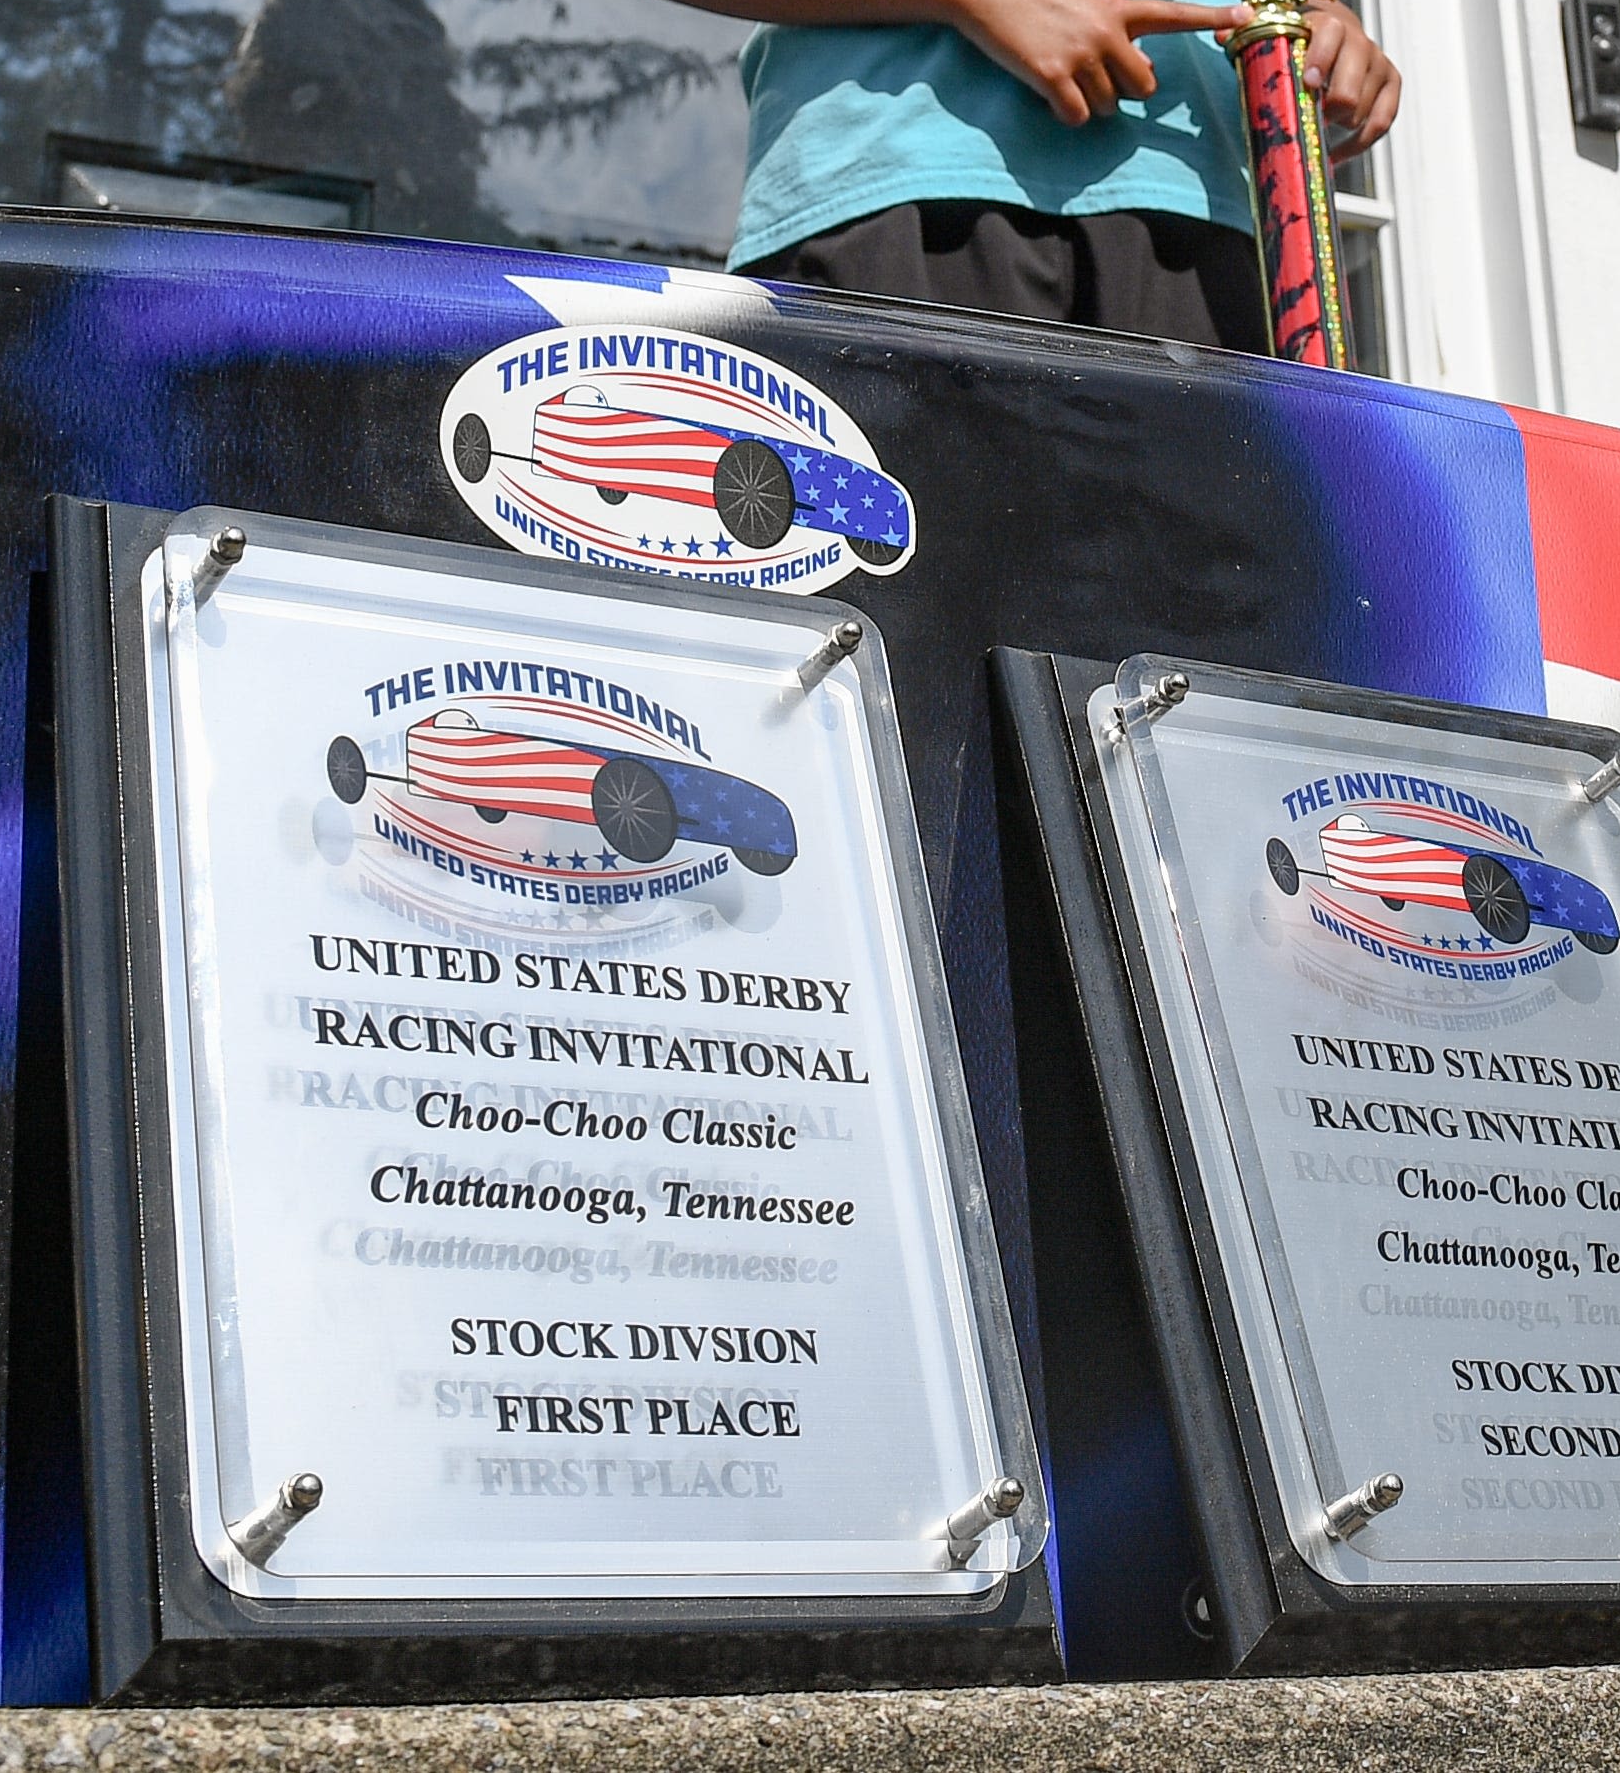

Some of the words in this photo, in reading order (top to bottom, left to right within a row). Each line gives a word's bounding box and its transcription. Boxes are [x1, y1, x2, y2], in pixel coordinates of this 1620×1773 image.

[497, 334, 571, 394] THE
[580, 334, 837, 448] INVITATIONAL
[495, 494, 582, 563] UNITED
[759, 542, 842, 588] RACING
[365, 664, 436, 718] THE
[445, 660, 713, 762] INVITATIONAL
[1282, 778, 1334, 822] THE
[1334, 773, 1544, 859] INVITATIONAL
[373, 813, 465, 877] UNITED
[470, 861, 560, 903] STATES
[564, 881, 645, 906] DERBY
[647, 852, 730, 900] RACING
[1309, 904, 1386, 959] UNITED
[1387, 945, 1459, 980] STATES
[1458, 962, 1518, 982] DERBY
[1518, 934, 1575, 977] RACING
[309, 933, 502, 986] UNITED
[514, 954, 688, 1003] STATES
[697, 969, 852, 1016] DERBY
[312, 1007, 519, 1060] RACING
[528, 1025, 870, 1085] INVITATIONAL
[1290, 1033, 1435, 1076] UNITED
[1442, 1048, 1574, 1090] STATES
[414, 1090, 649, 1141] Choo-Choo
[662, 1108, 798, 1151] Classic
[1306, 1096, 1461, 1139] RACING
[369, 1164, 648, 1224] Chattanooga,
[662, 1180, 856, 1226] Tennessee
[1396, 1166, 1567, 1209] Choo-Choo
[1376, 1230, 1582, 1280] Chattanooga,
[450, 1317, 619, 1359] STOCK
[625, 1323, 820, 1365] DIVSION
[1451, 1358, 1577, 1394] STOCK
[492, 1394, 635, 1434] FIRST
[644, 1397, 802, 1438] PLACE
